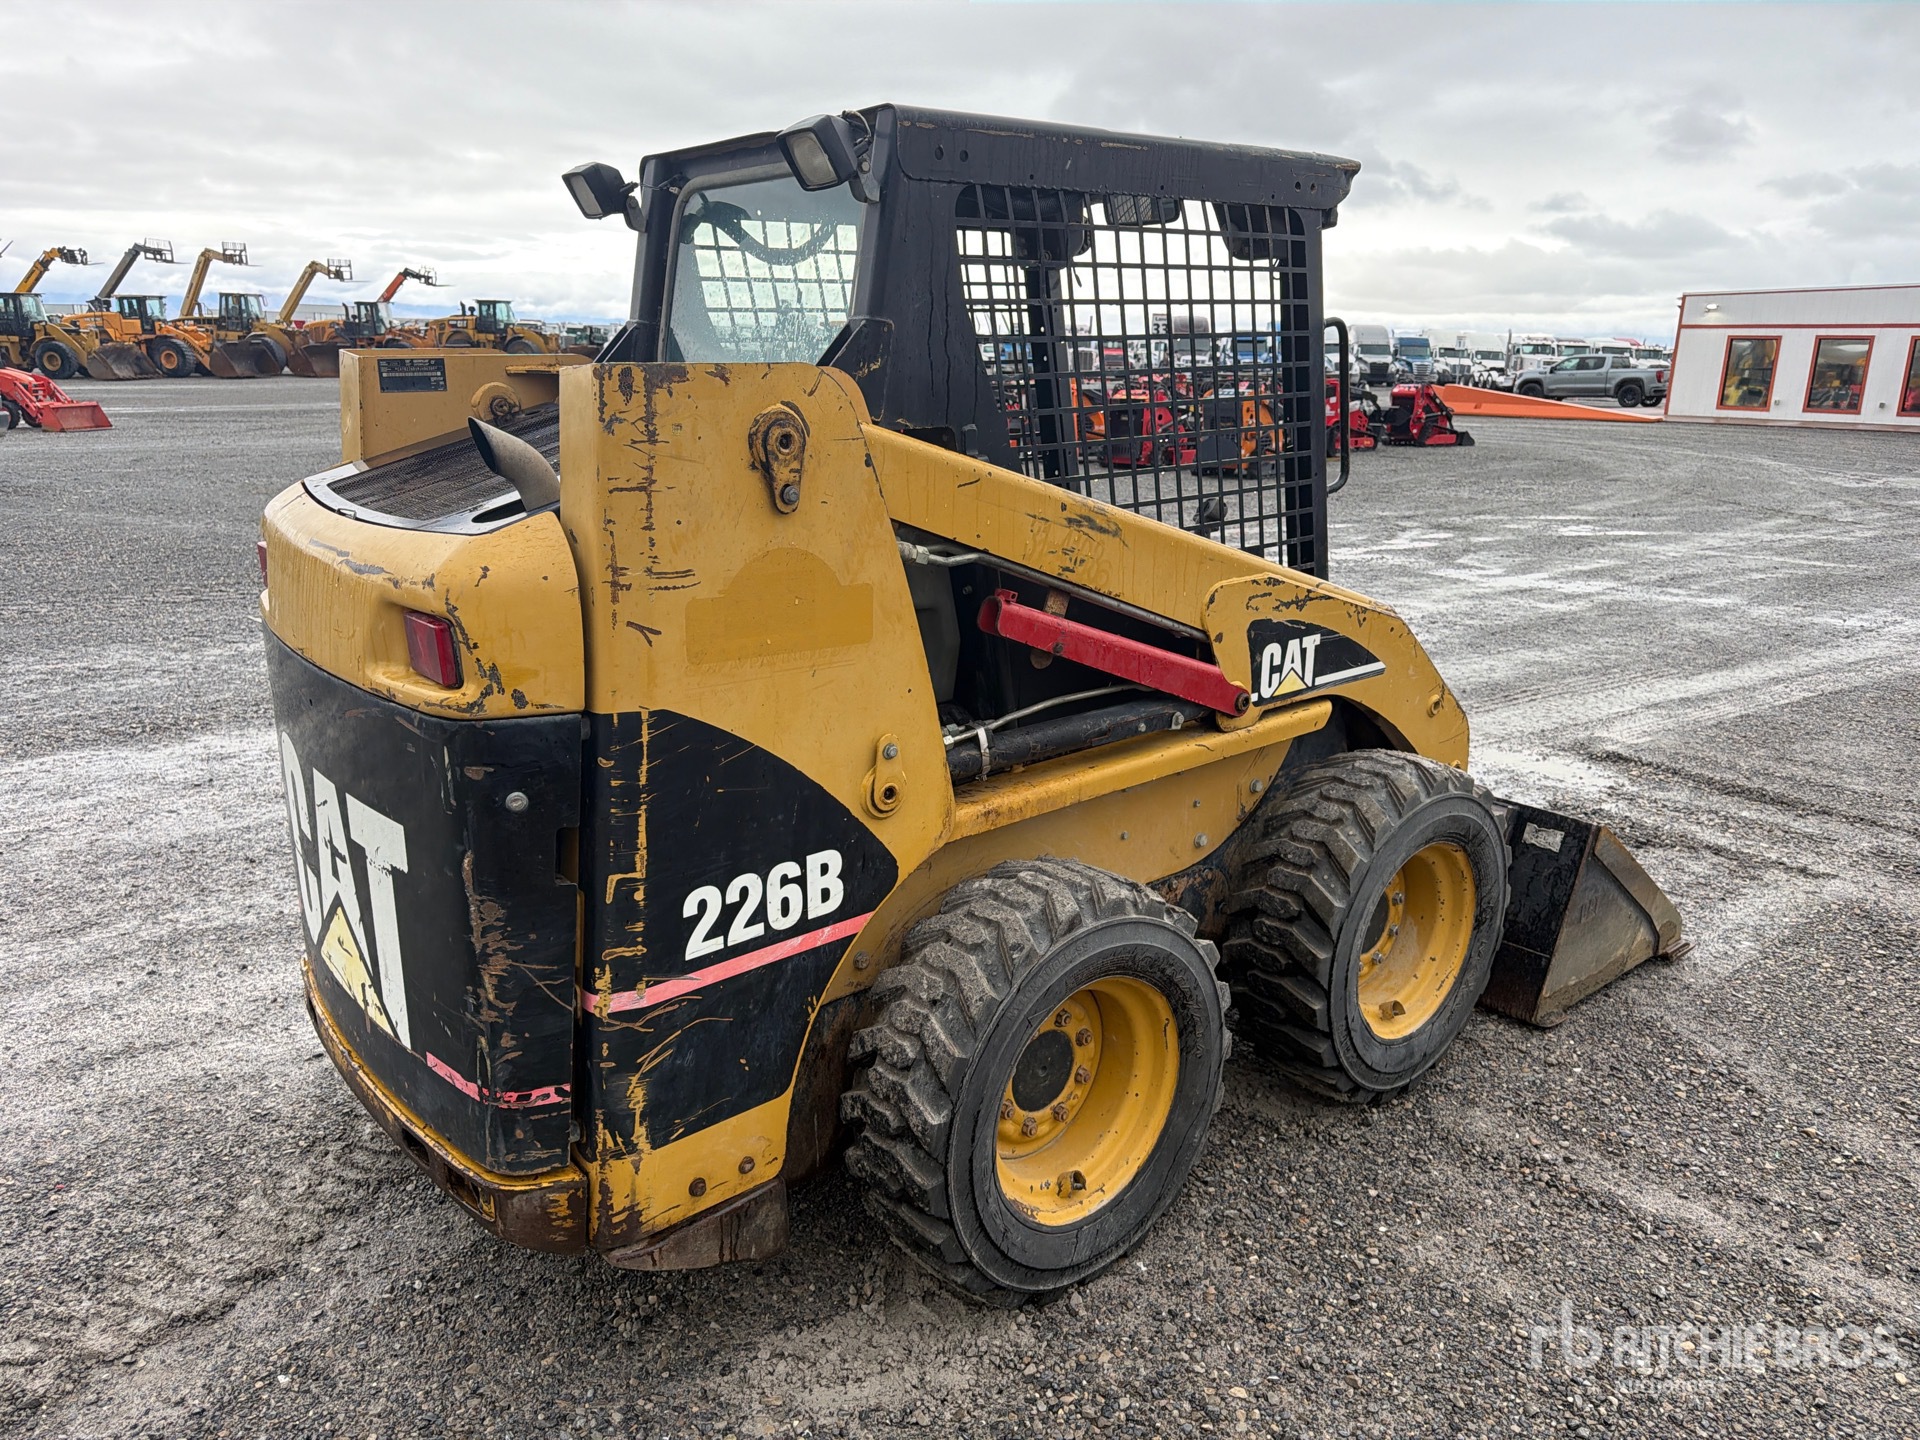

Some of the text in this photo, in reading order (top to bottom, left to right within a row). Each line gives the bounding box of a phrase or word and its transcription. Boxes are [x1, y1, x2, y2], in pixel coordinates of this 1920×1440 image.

[1260, 634, 1321, 698] CAT
[282, 731, 411, 1050] CAT
[683, 849, 844, 961] 226B
